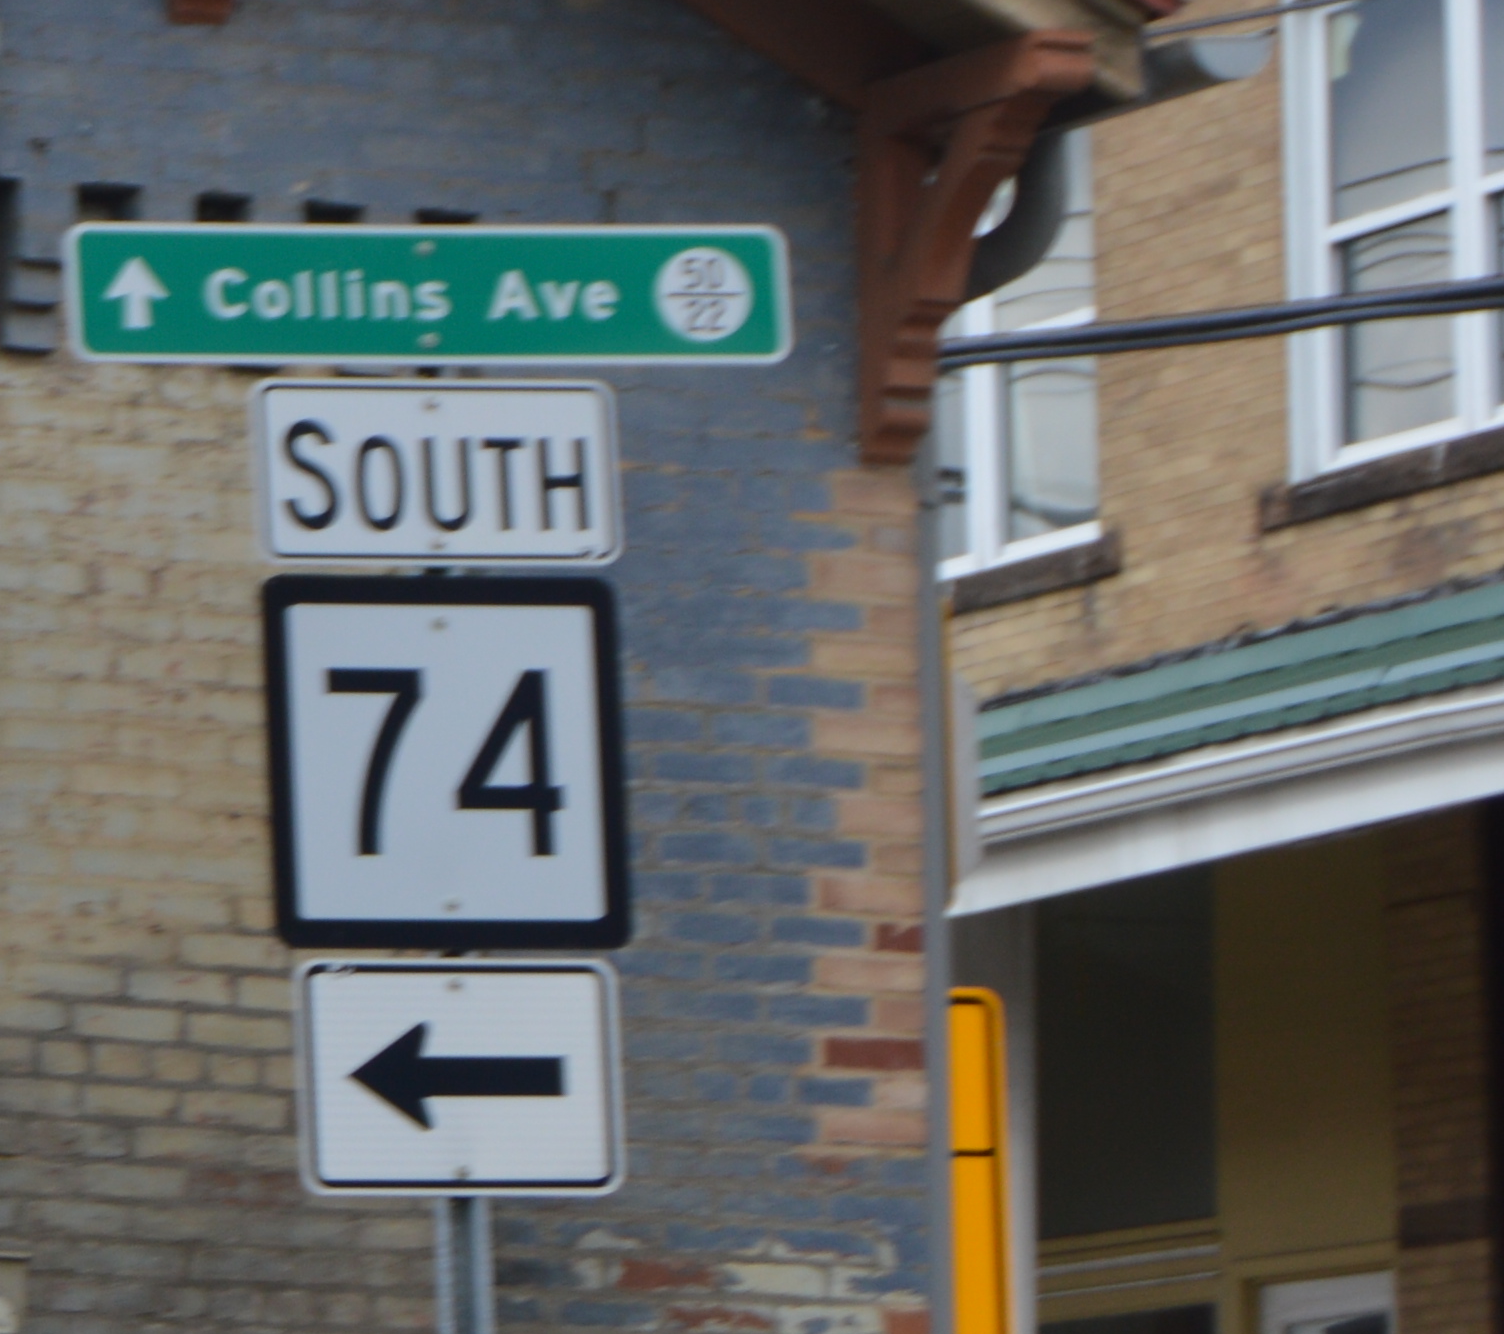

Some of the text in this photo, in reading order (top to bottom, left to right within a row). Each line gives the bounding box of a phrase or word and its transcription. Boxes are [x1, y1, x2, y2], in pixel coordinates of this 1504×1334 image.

[203, 267, 621, 323] Collins Ave
[676, 256, 727, 289] 50
[678, 299, 730, 332] 22
[282, 418, 593, 532] SOUTH
[324, 668, 565, 857] 74
